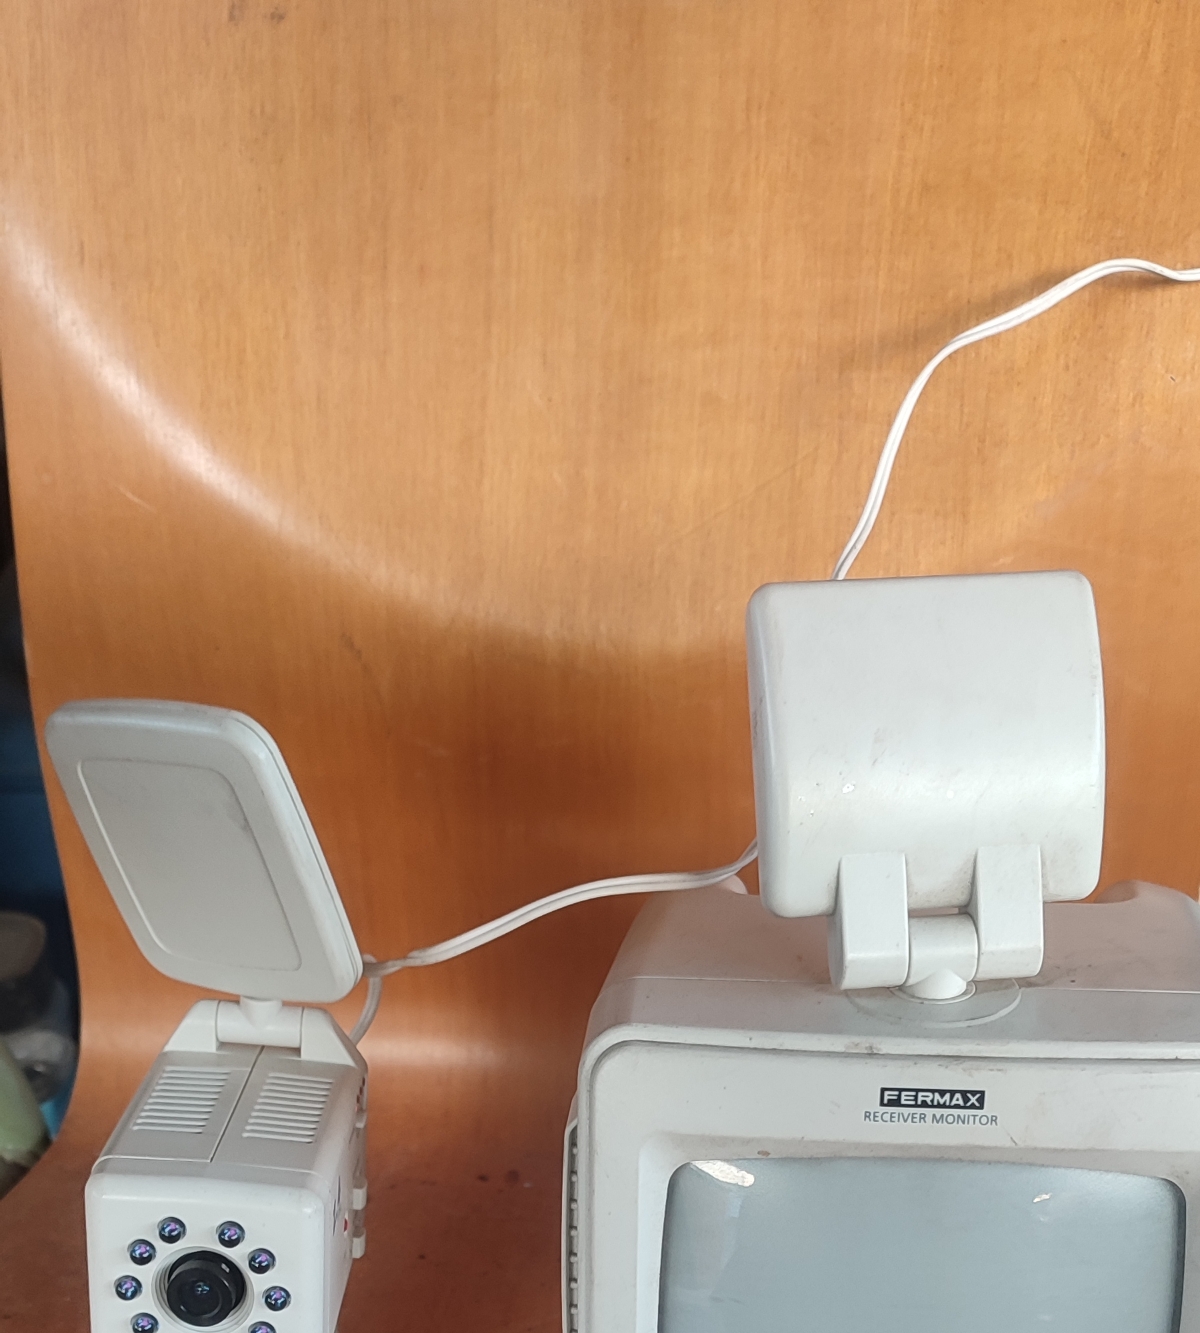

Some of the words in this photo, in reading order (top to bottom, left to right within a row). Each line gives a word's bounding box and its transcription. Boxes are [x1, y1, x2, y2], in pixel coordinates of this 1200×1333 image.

[883, 1090, 981, 1107] FERMAX
[863, 1110, 927, 1124] RECEIVER
[931, 1113, 998, 1126] MONITOR
